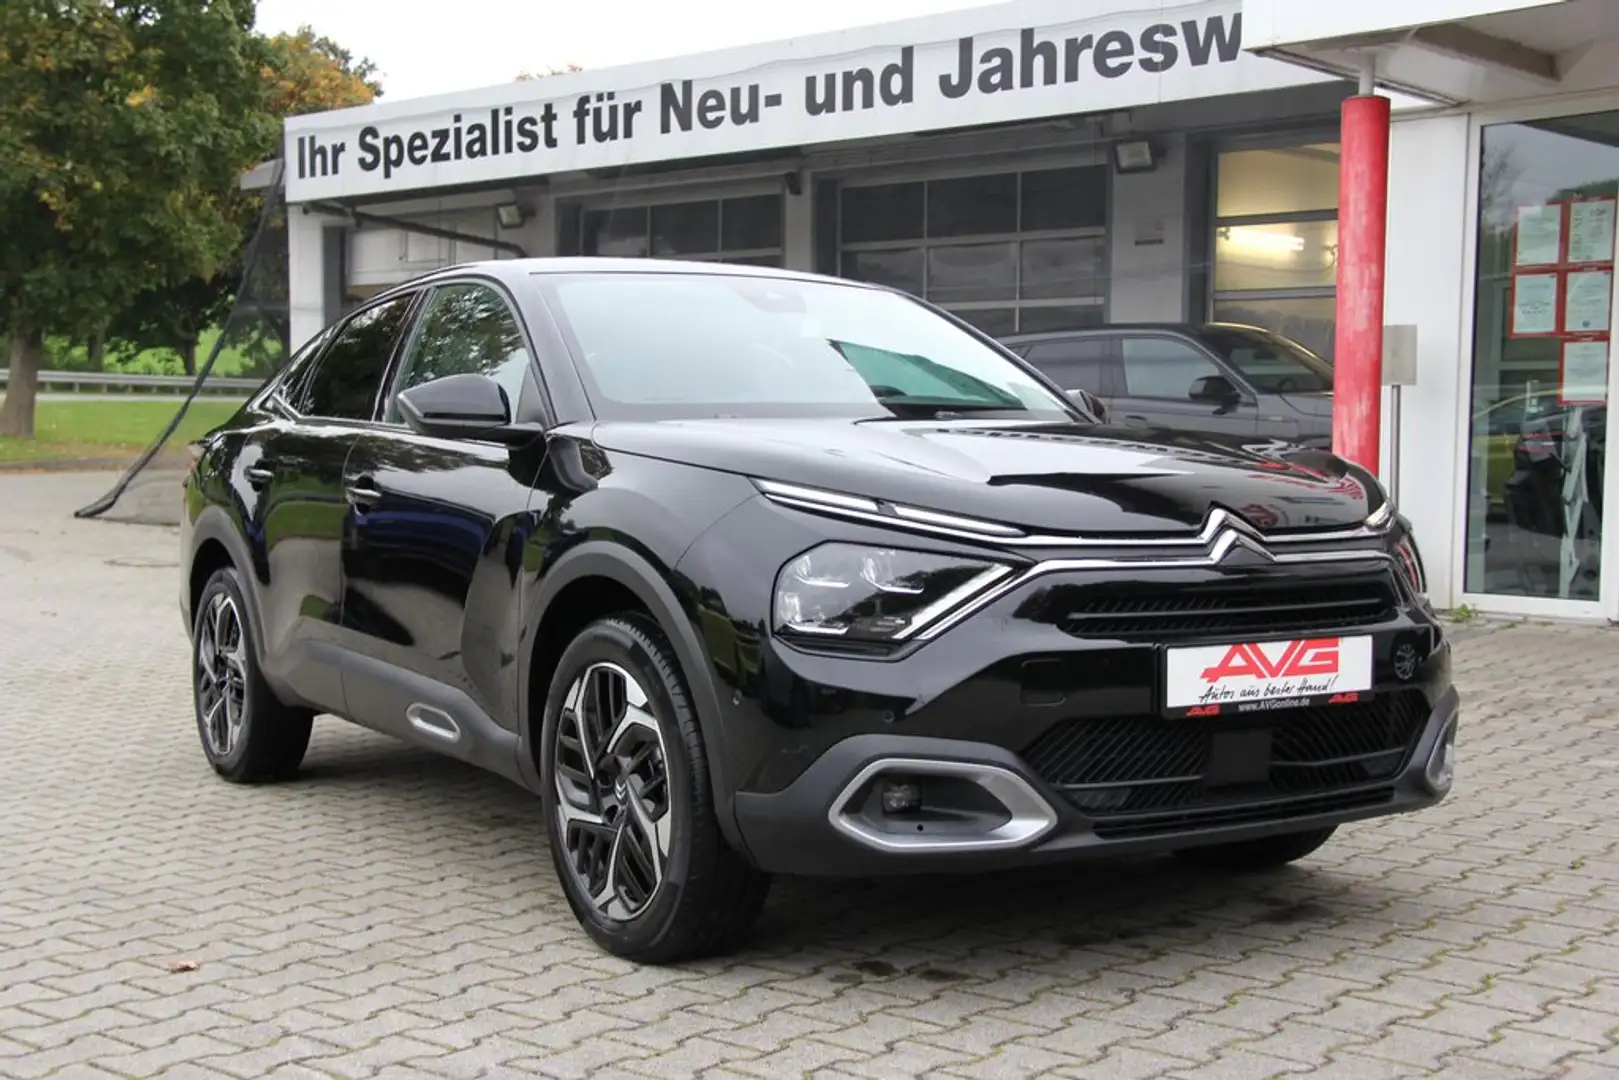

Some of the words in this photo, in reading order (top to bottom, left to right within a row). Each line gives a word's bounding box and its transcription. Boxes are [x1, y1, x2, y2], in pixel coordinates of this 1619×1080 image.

[297, 134, 346, 179] Ihr
[357, 103, 558, 179] Spezialist
[573, 91, 642, 145] für
[659, 80, 782, 134] Neu-
[805, 46, 914, 116] und
[1200, 636, 1339, 683] AVG
